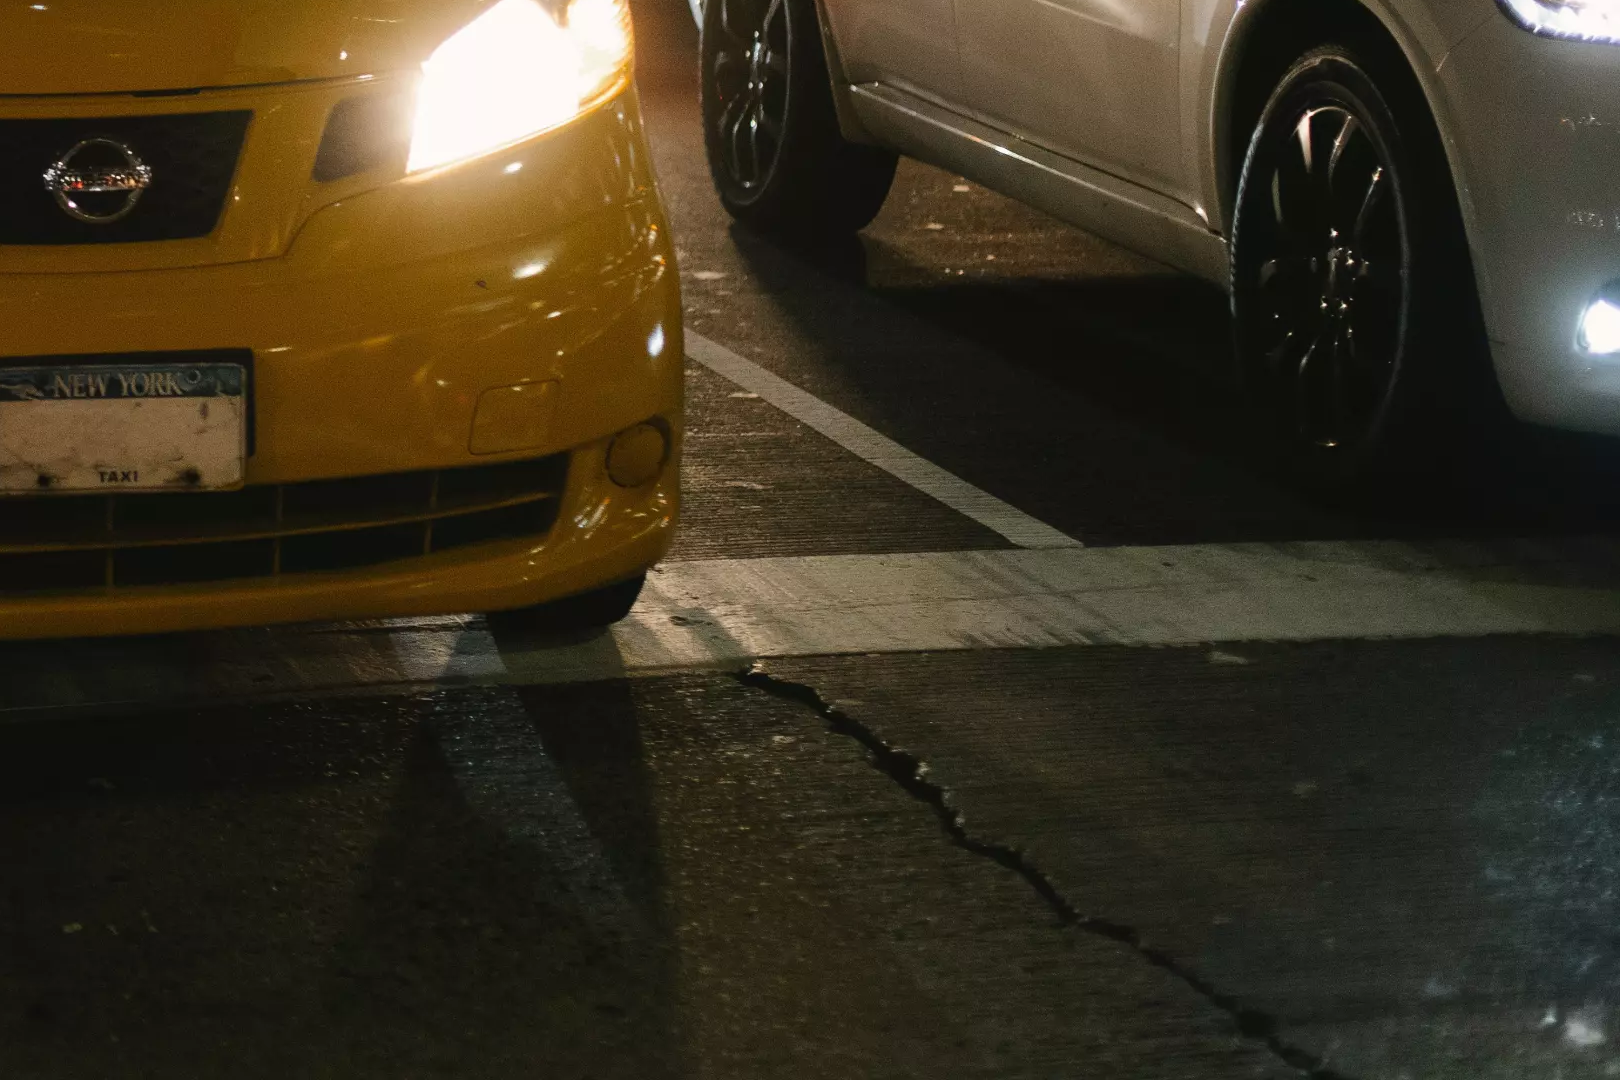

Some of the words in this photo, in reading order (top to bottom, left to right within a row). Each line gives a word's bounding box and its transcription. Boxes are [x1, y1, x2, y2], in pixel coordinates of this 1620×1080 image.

[53, 372, 110, 398] NEW
[119, 371, 183, 397] YORK
[98, 470, 139, 483] TAXI
